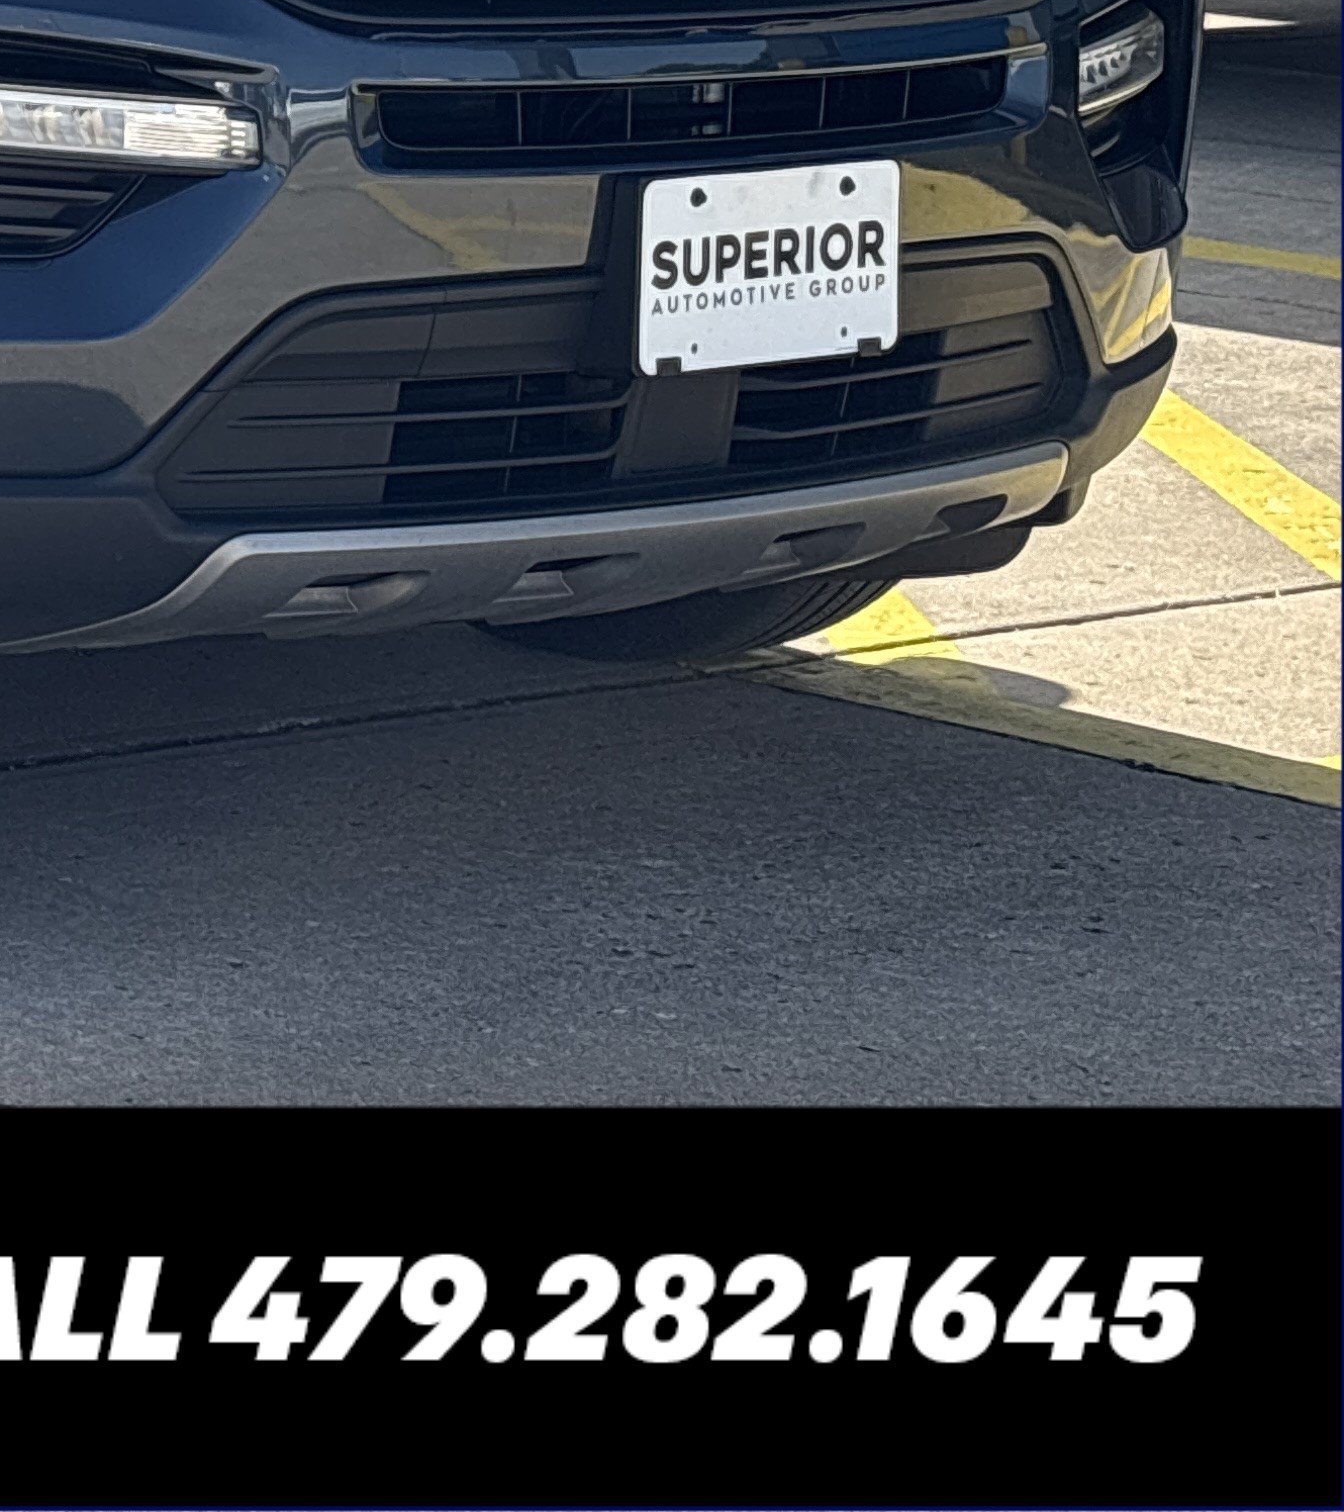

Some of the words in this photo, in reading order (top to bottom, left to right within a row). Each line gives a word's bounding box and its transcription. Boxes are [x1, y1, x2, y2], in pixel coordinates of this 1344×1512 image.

[650, 219, 887, 291] SUPERIOR
[651, 281, 797, 316] AUTOMOTIVE
[809, 273, 887, 299] GROUP
